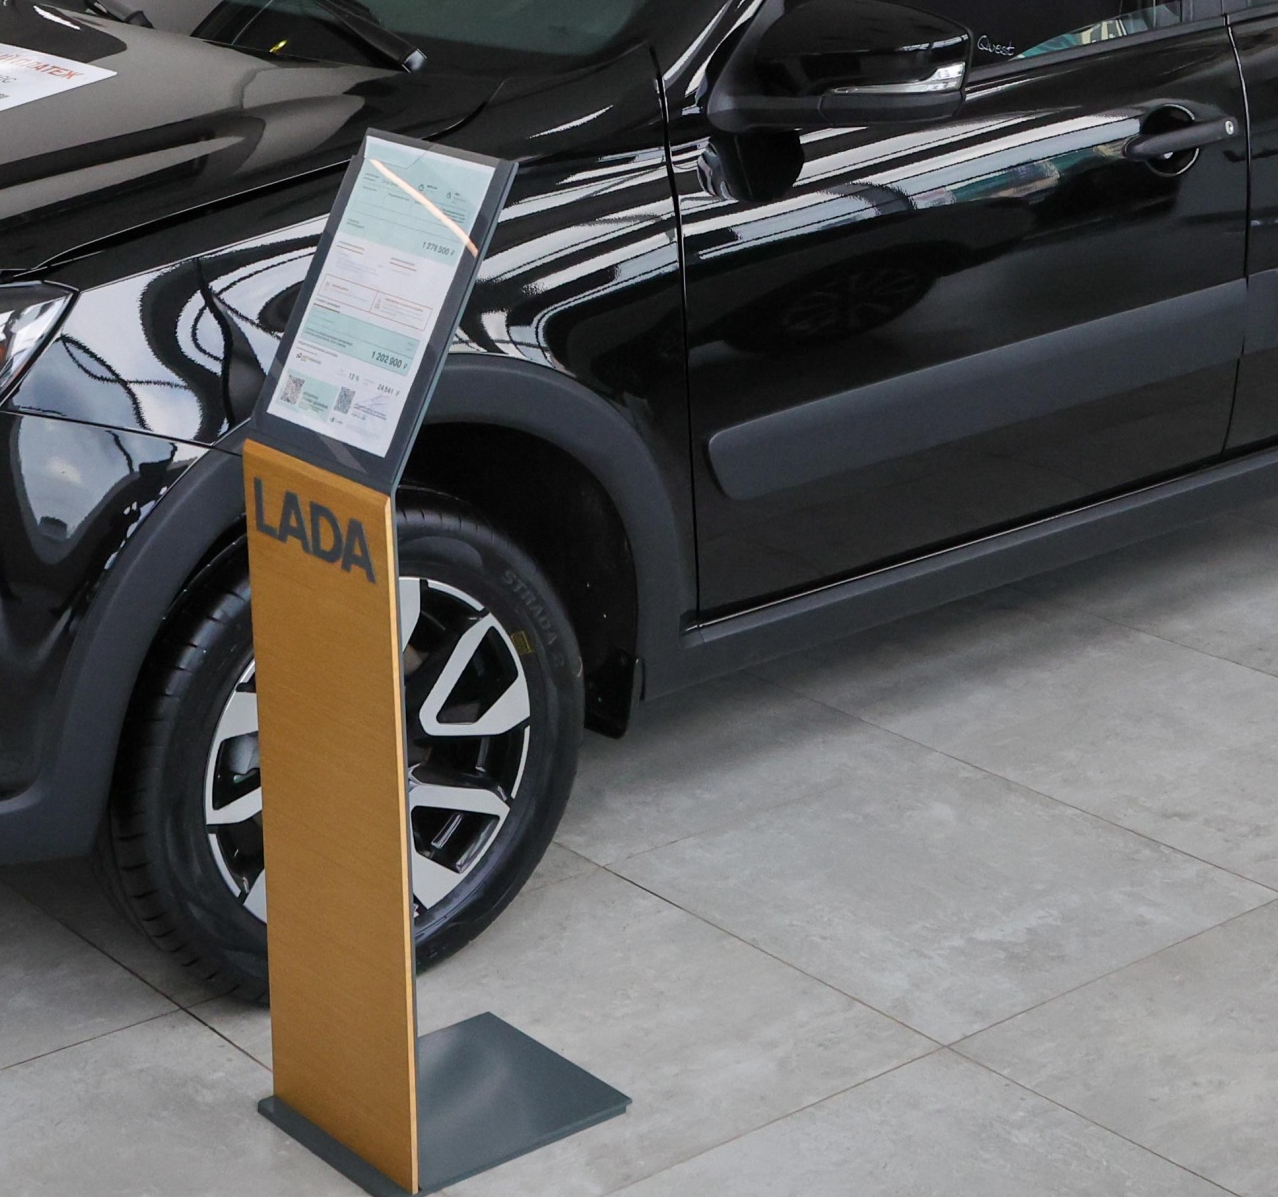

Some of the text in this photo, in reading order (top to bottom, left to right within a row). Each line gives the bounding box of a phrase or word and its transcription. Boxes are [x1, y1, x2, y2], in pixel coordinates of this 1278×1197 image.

[376, 352, 389, 363] 202
[388, 357, 402, 368] 900
[253, 477, 377, 583] LADA
